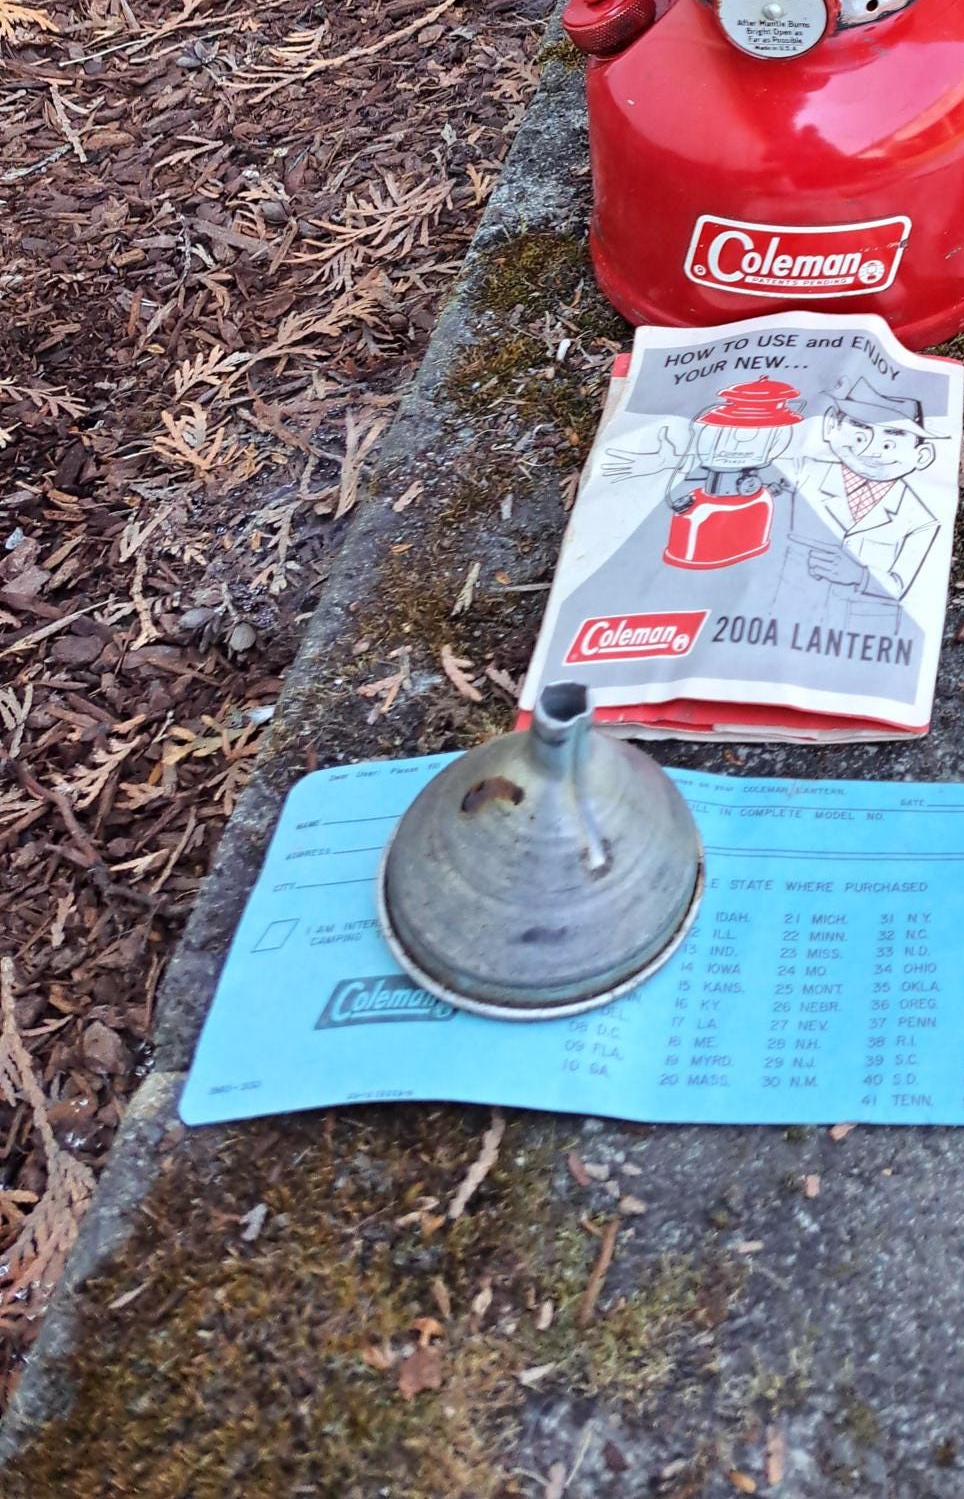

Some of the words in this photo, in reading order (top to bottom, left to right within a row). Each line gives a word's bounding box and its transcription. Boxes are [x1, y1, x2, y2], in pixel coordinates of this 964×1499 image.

[788, 20, 810, 28] Burns
[747, 28, 771, 36] Bright
[773, 28, 792, 36] Open
[707, 230, 862, 283] Coleman
[752, 277, 798, 285] PATENTS
[803, 277, 847, 285] PENDING
[664, 346, 715, 368] HOW
[723, 338, 750, 352] TO
[757, 334, 800, 348] USE
[806, 336, 844, 348] and
[851, 336, 901, 382] ENJOY
[673, 360, 727, 385] YOUR
[581, 621, 674, 655] Coleman
[712, 615, 779, 646] 200A
[790, 622, 914, 667] LANTERN
[720, 807, 732, 817] IN
[739, 808, 802, 818] COMPLETE
[815, 810, 856, 821] MODEL
[729, 879, 774, 891] STATE
[785, 881, 834, 893] WHERE
[844, 882, 929, 893] PURCHASED
[784, 913, 800, 924] 21
[783, 930, 799, 941] 22
[707, 963, 741, 975] IOWA
[874, 963, 893, 975] 34
[903, 963, 937, 974] OHIO
[330, 980, 437, 1021] Coleman
